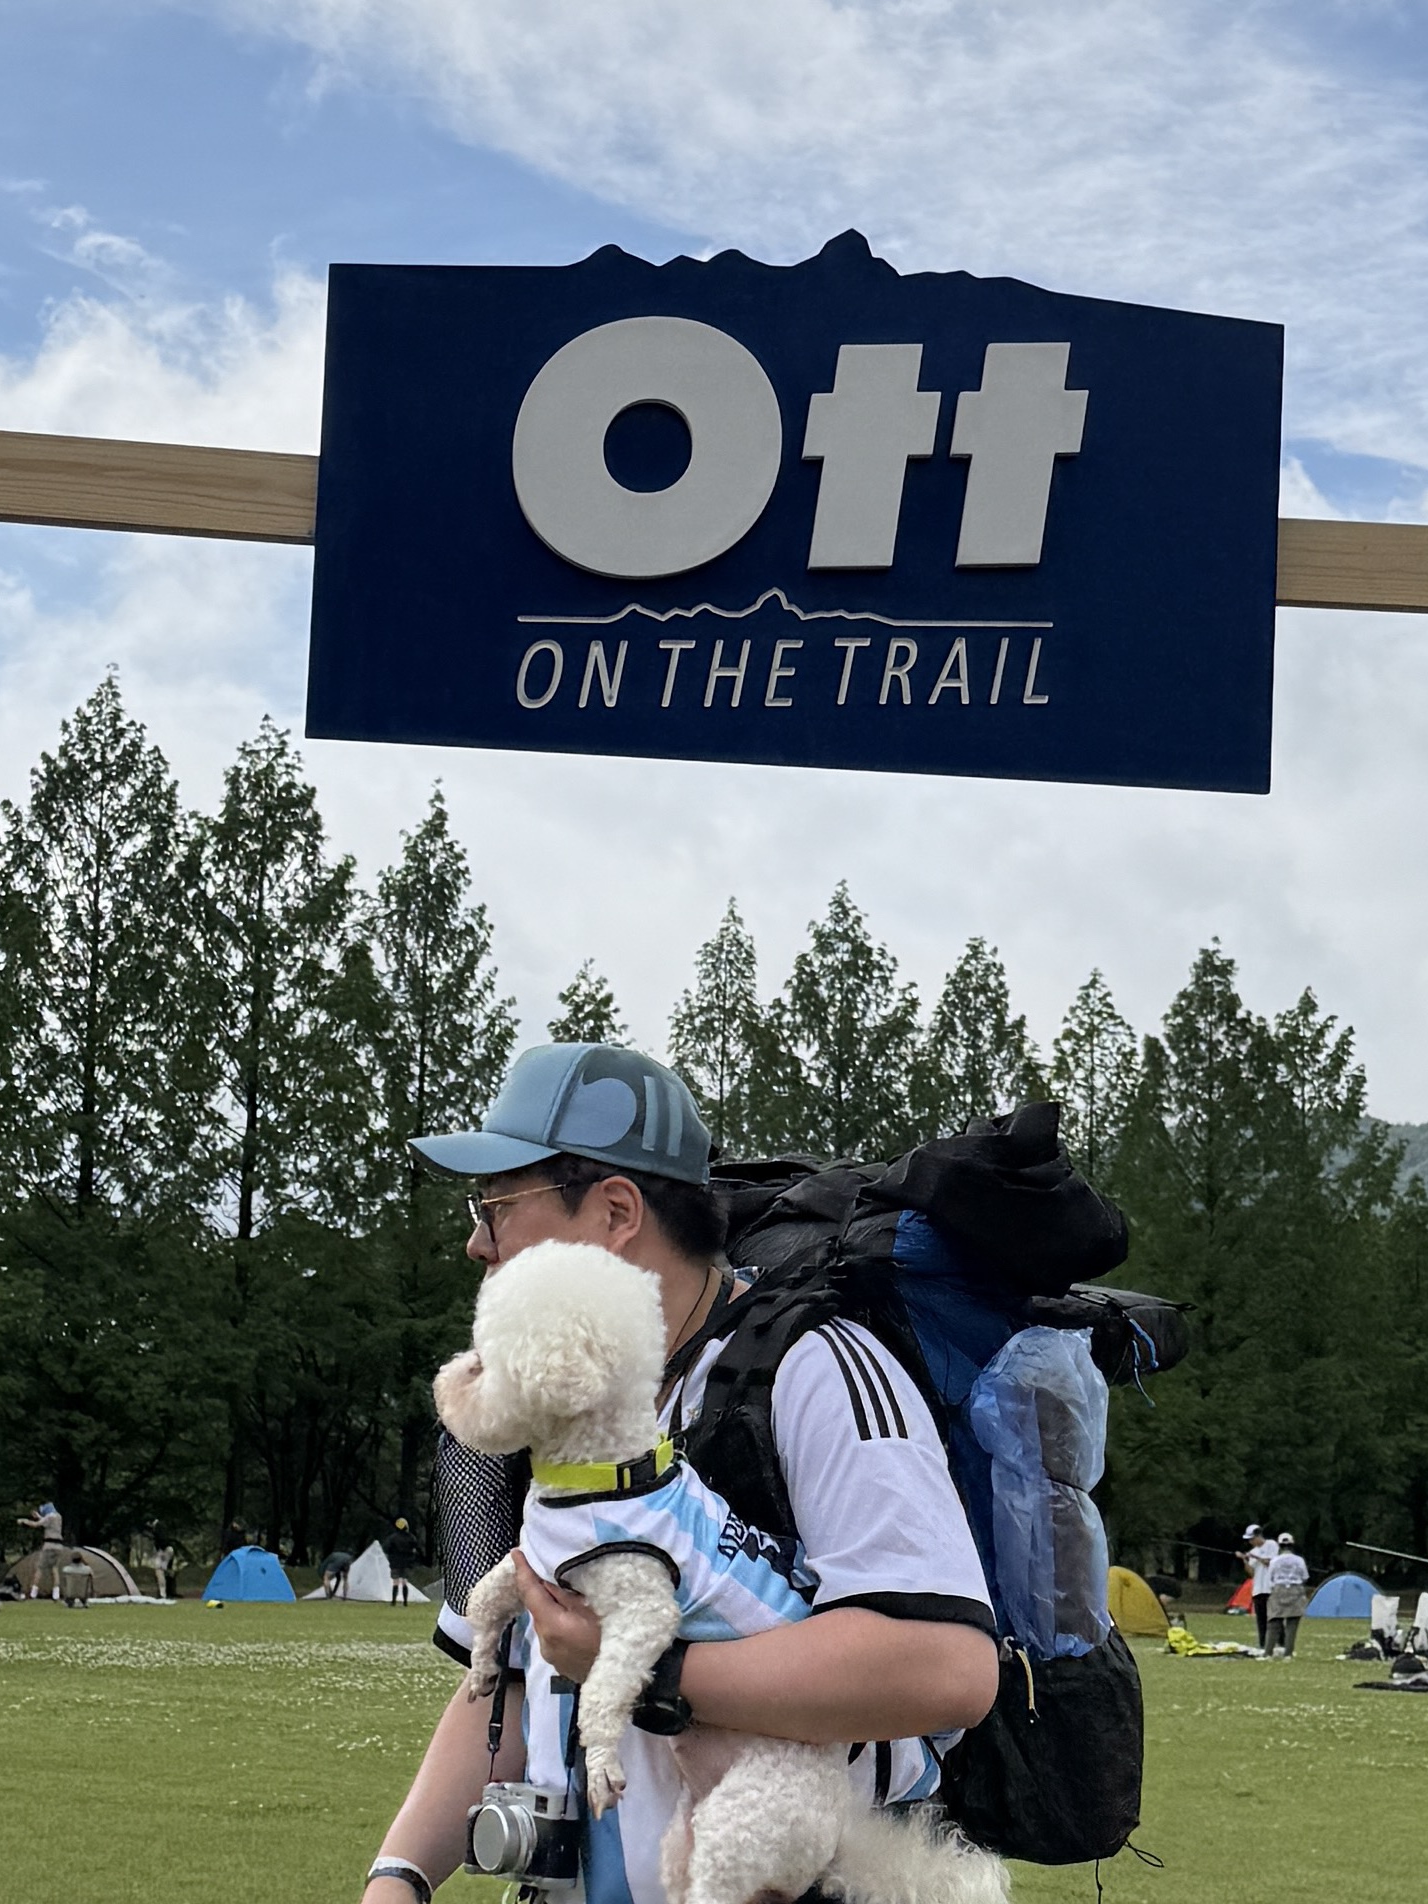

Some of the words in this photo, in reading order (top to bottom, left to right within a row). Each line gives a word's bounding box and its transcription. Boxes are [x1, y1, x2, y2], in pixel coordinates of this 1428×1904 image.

[512, 316, 1089, 579] Ott
[516, 639, 628, 709] ON
[658, 638, 804, 707] THE
[834, 636, 1049, 705] TRAIL
